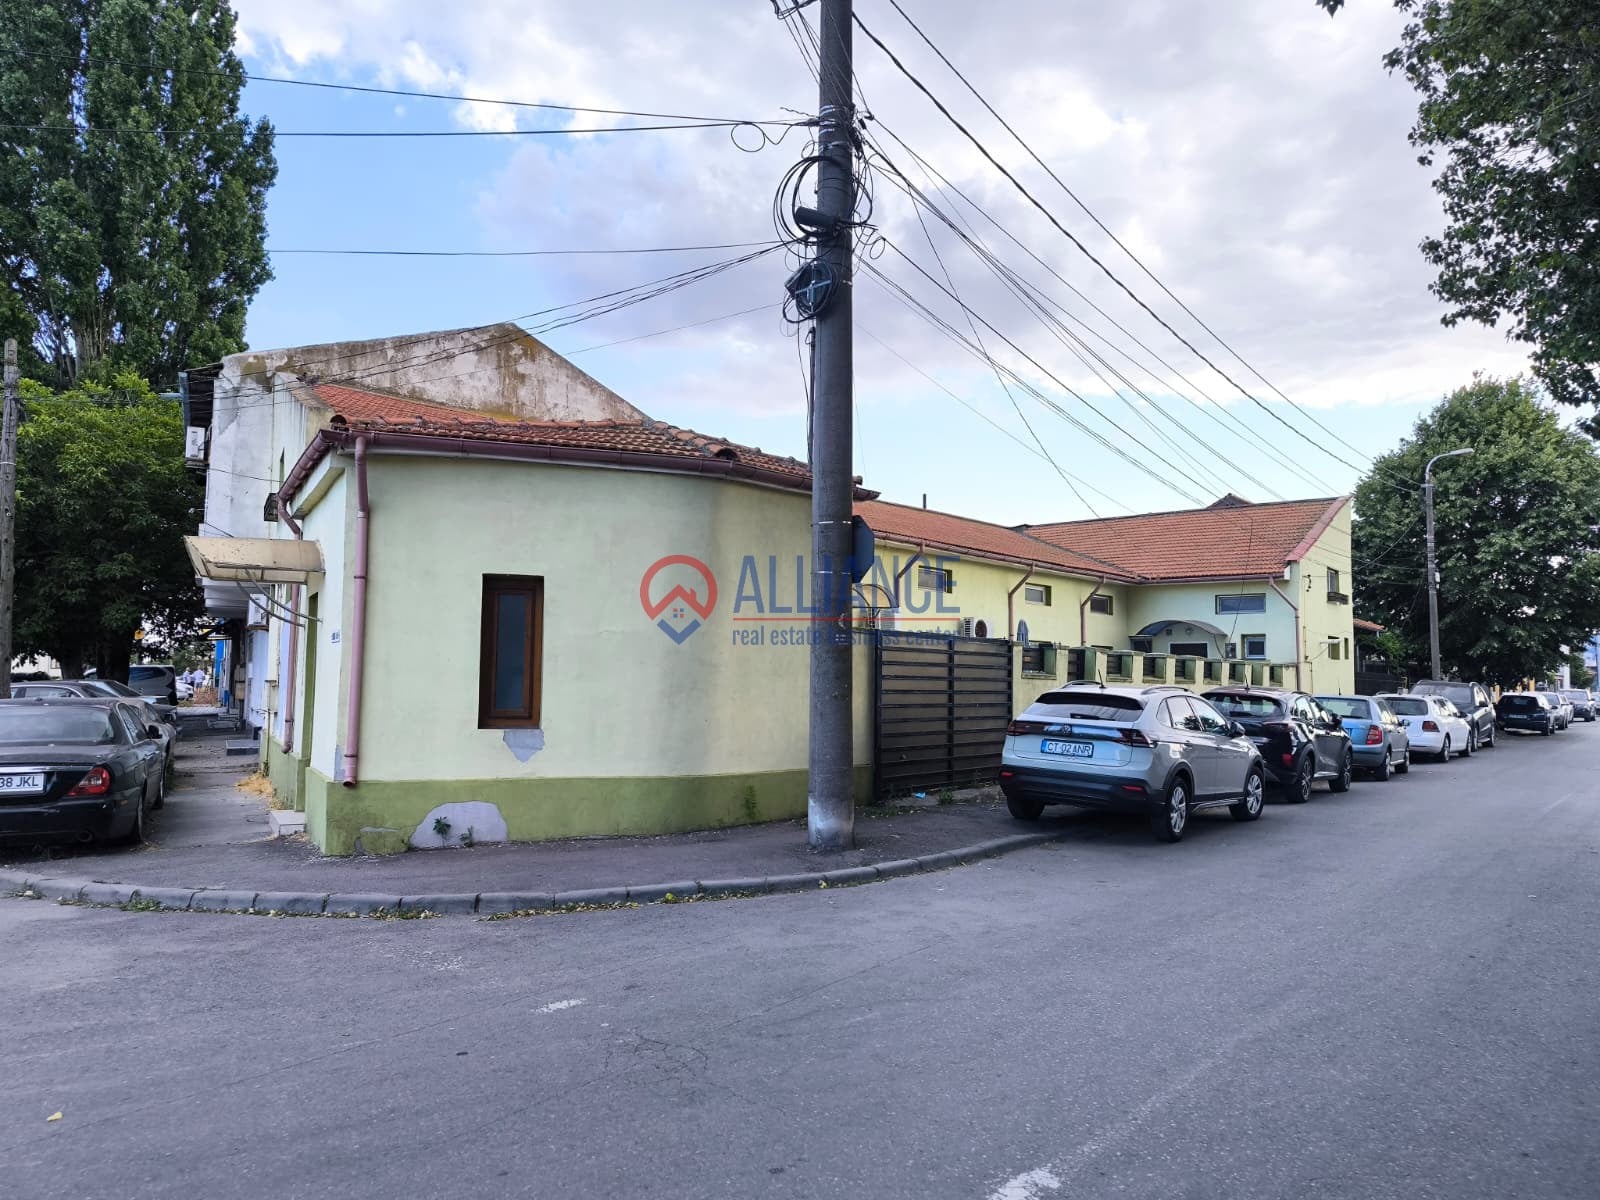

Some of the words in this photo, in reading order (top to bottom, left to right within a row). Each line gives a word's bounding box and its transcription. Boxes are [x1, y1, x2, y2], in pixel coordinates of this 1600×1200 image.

[1047, 742, 1059, 752] CT
[1061, 743, 1072, 753] 02
[16, 775, 39, 788] JKL
